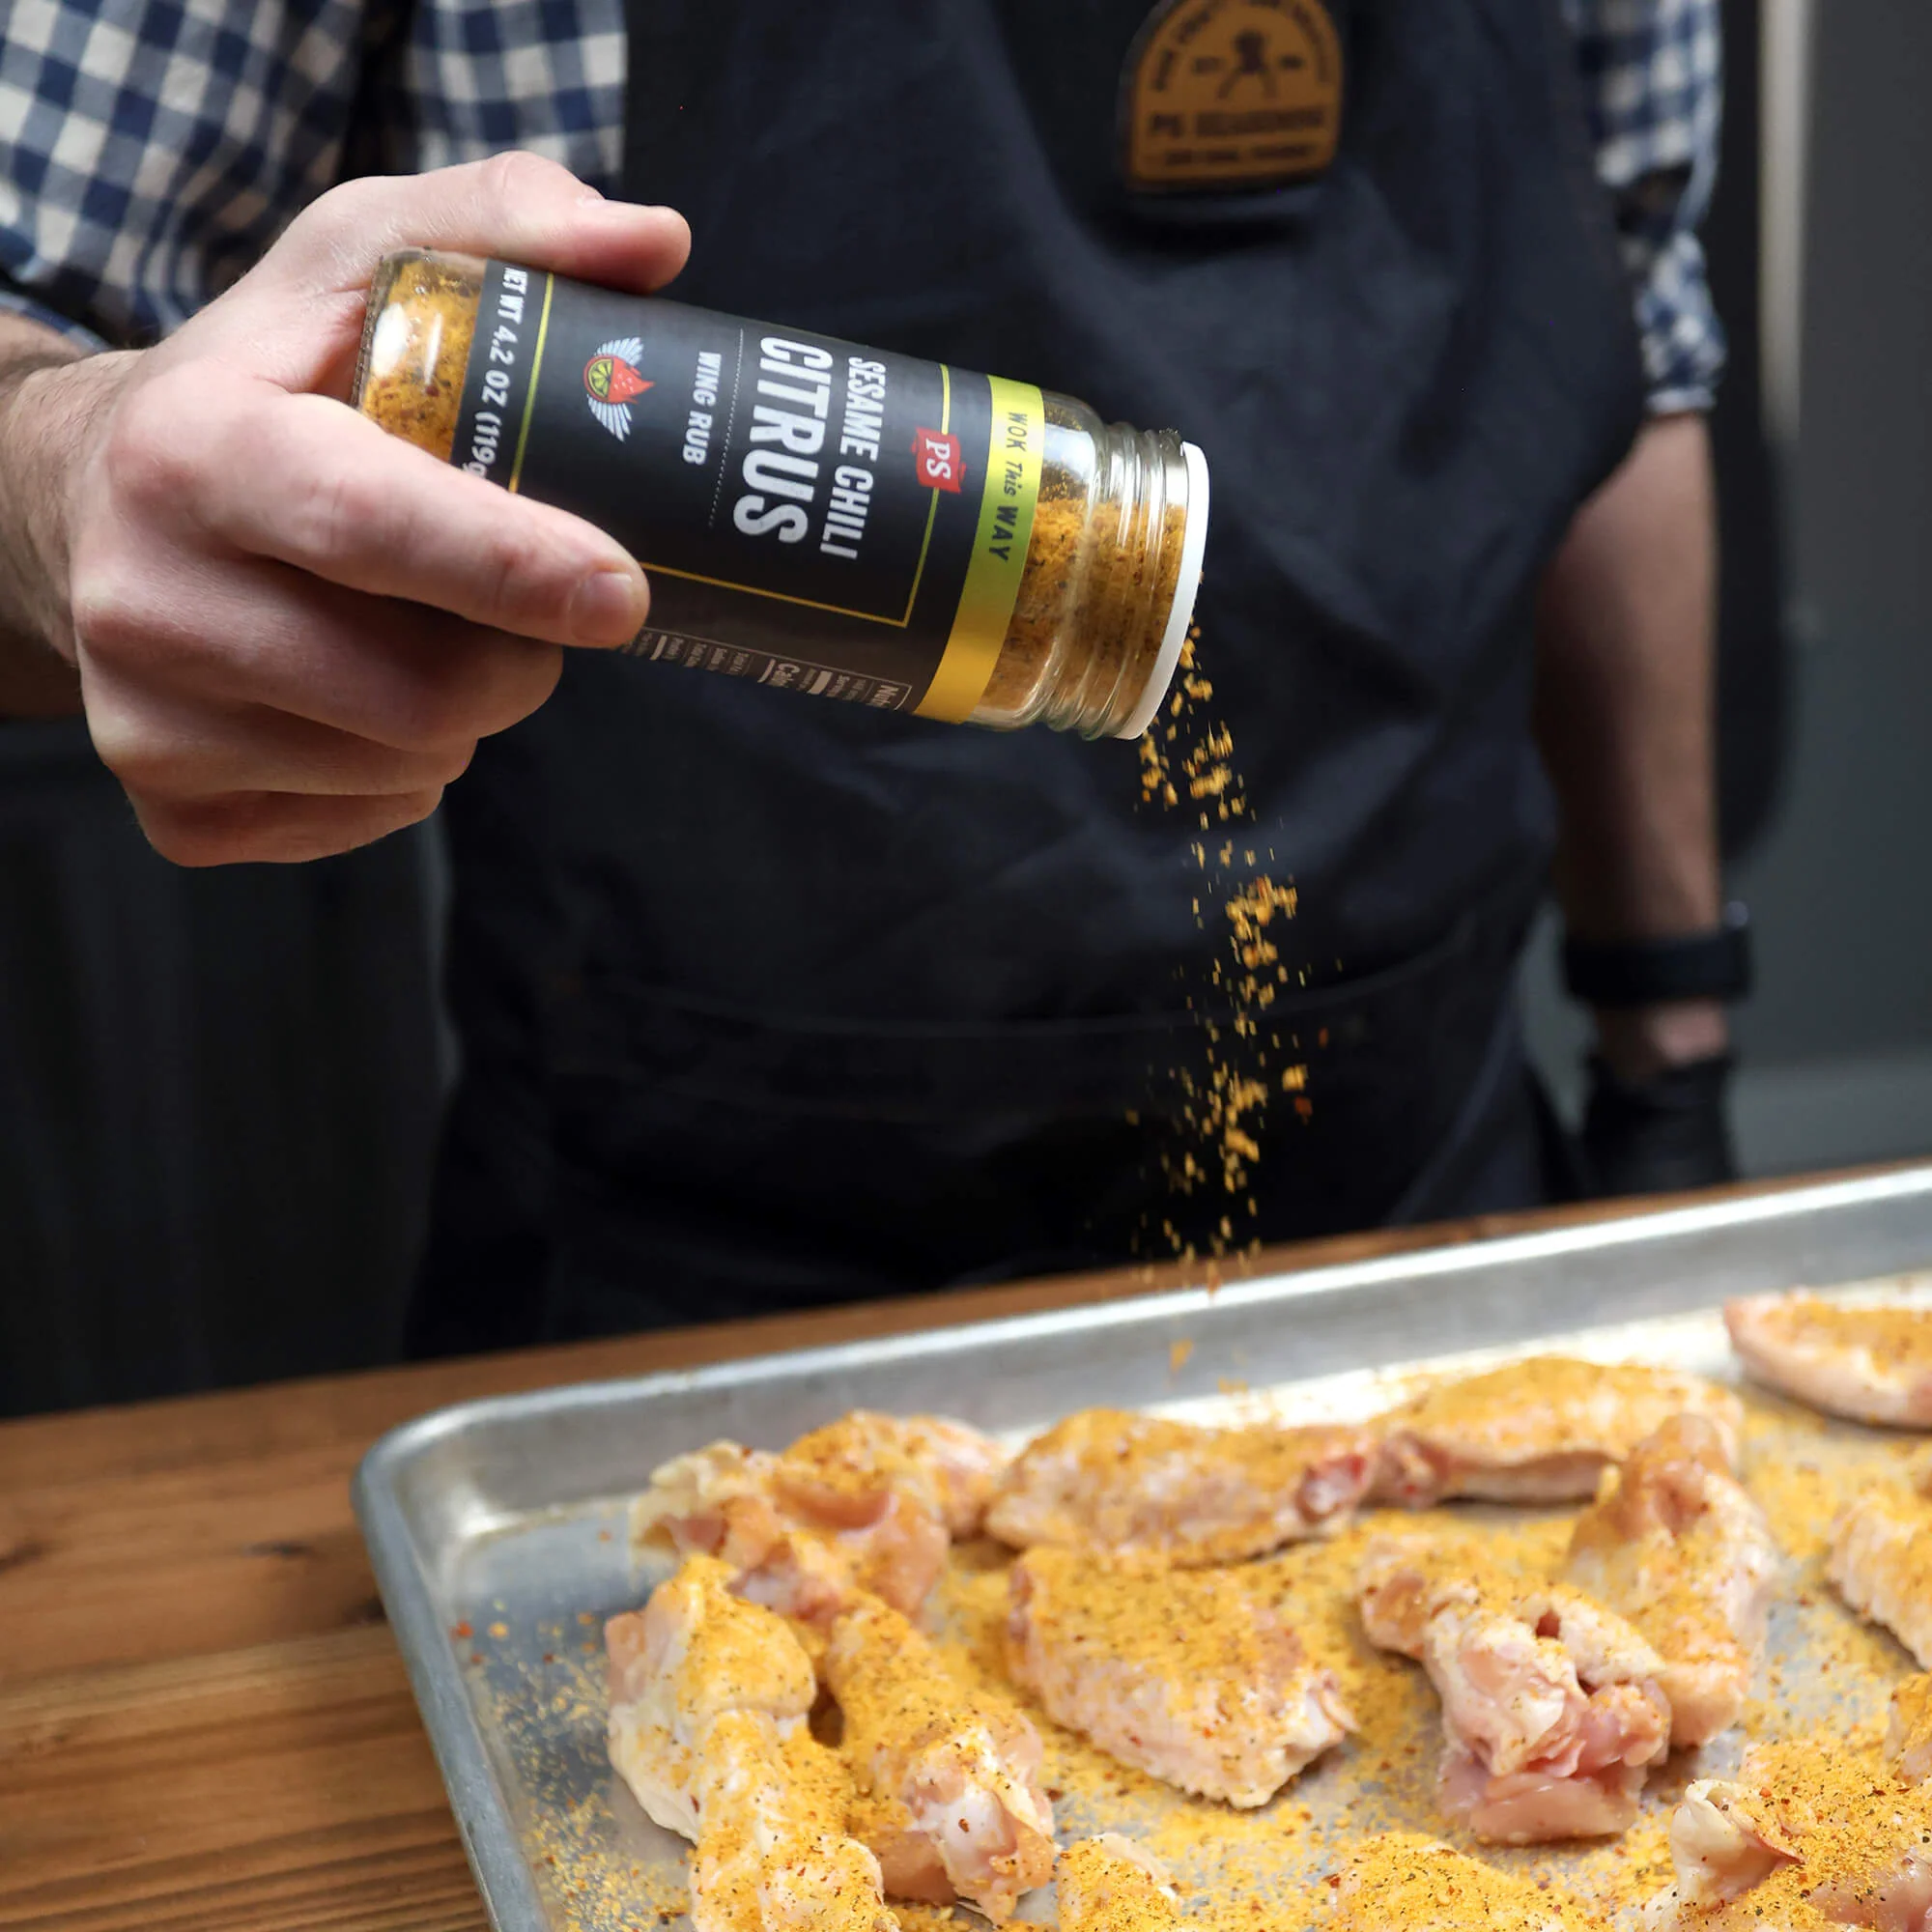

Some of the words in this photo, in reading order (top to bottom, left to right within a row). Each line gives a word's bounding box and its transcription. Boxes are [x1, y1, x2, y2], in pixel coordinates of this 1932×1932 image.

[502, 267, 527, 295] NET
[497, 294, 524, 325] WT
[489, 325, 519, 366] 4.2
[481, 369, 511, 407] OZ
[693, 351, 722, 407] WING
[839, 355, 887, 462] SESAME
[1006, 412, 1029, 452] WOK
[682, 410, 713, 466] RUB
[733, 336, 834, 544] CITRUS
[925, 437, 952, 480] PS
[820, 465, 874, 560] CHILI
[988, 504, 1019, 562] WAY
